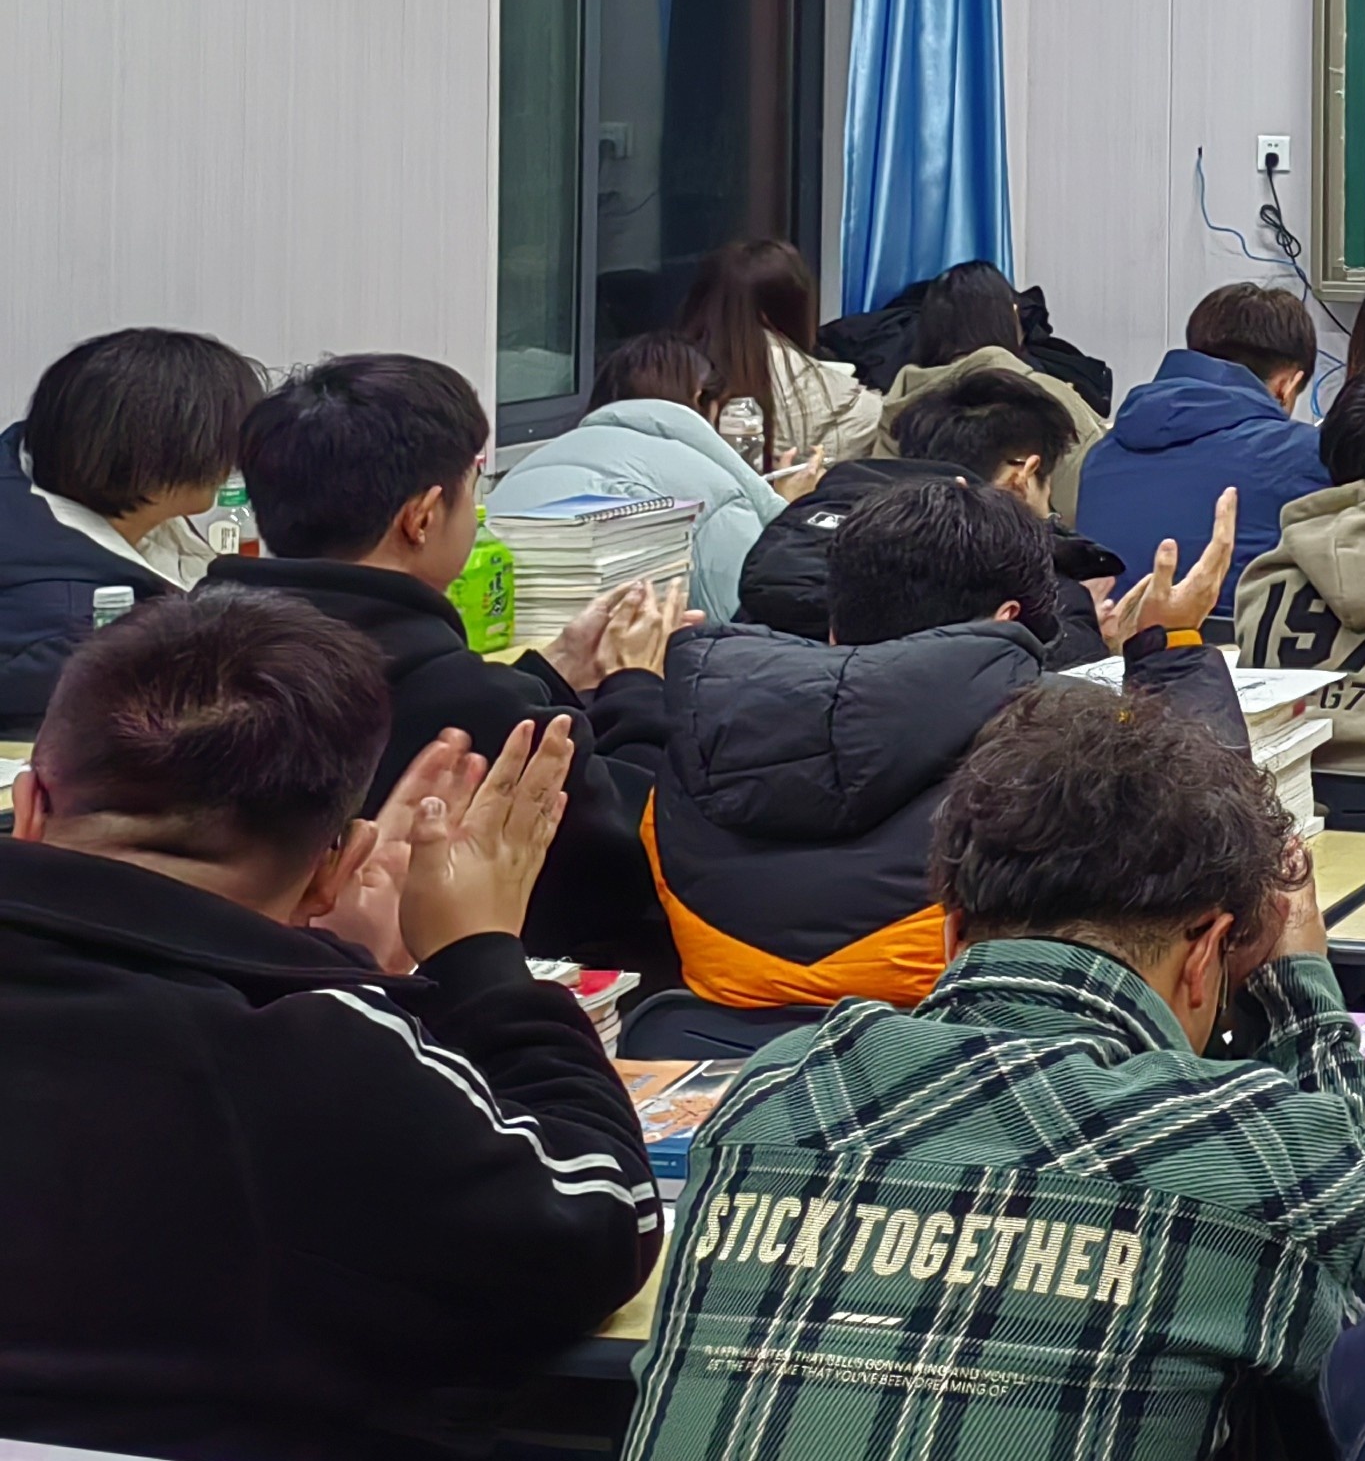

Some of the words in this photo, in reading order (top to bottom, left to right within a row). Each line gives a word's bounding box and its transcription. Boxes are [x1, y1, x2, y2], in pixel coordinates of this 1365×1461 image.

[696, 1193, 840, 1268] STICK
[842, 1203, 1144, 1306] TOGETHER
[801, 1365, 834, 1379] THAT
[879, 1373, 912, 1389] BEEN
[913, 1376, 986, 1395] DREAMING
[988, 1384, 1009, 1397] OF
[864, 1358, 912, 1373] GONNA
[950, 1366, 980, 1380] AND
